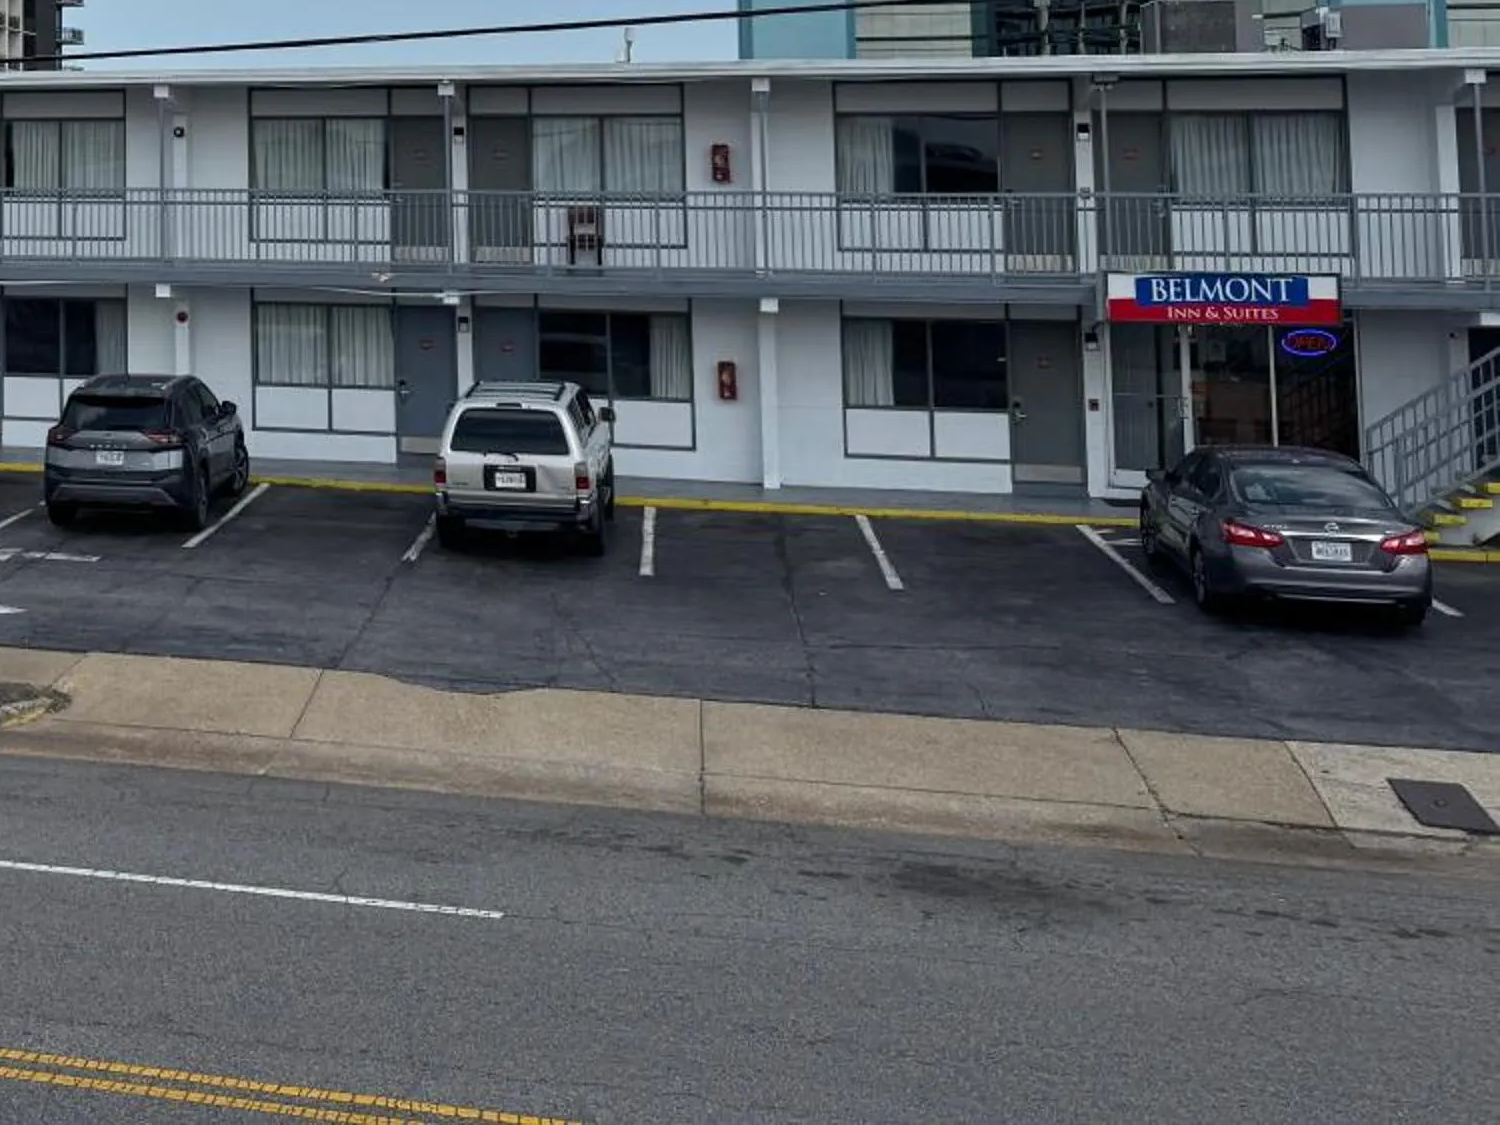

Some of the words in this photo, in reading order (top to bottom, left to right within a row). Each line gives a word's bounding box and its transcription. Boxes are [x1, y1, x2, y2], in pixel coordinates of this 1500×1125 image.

[1151, 277, 1293, 303] BELMONT
[1167, 306, 1200, 320] INN
[1205, 306, 1220, 320] &
[1223, 306, 1279, 320] SUITES
